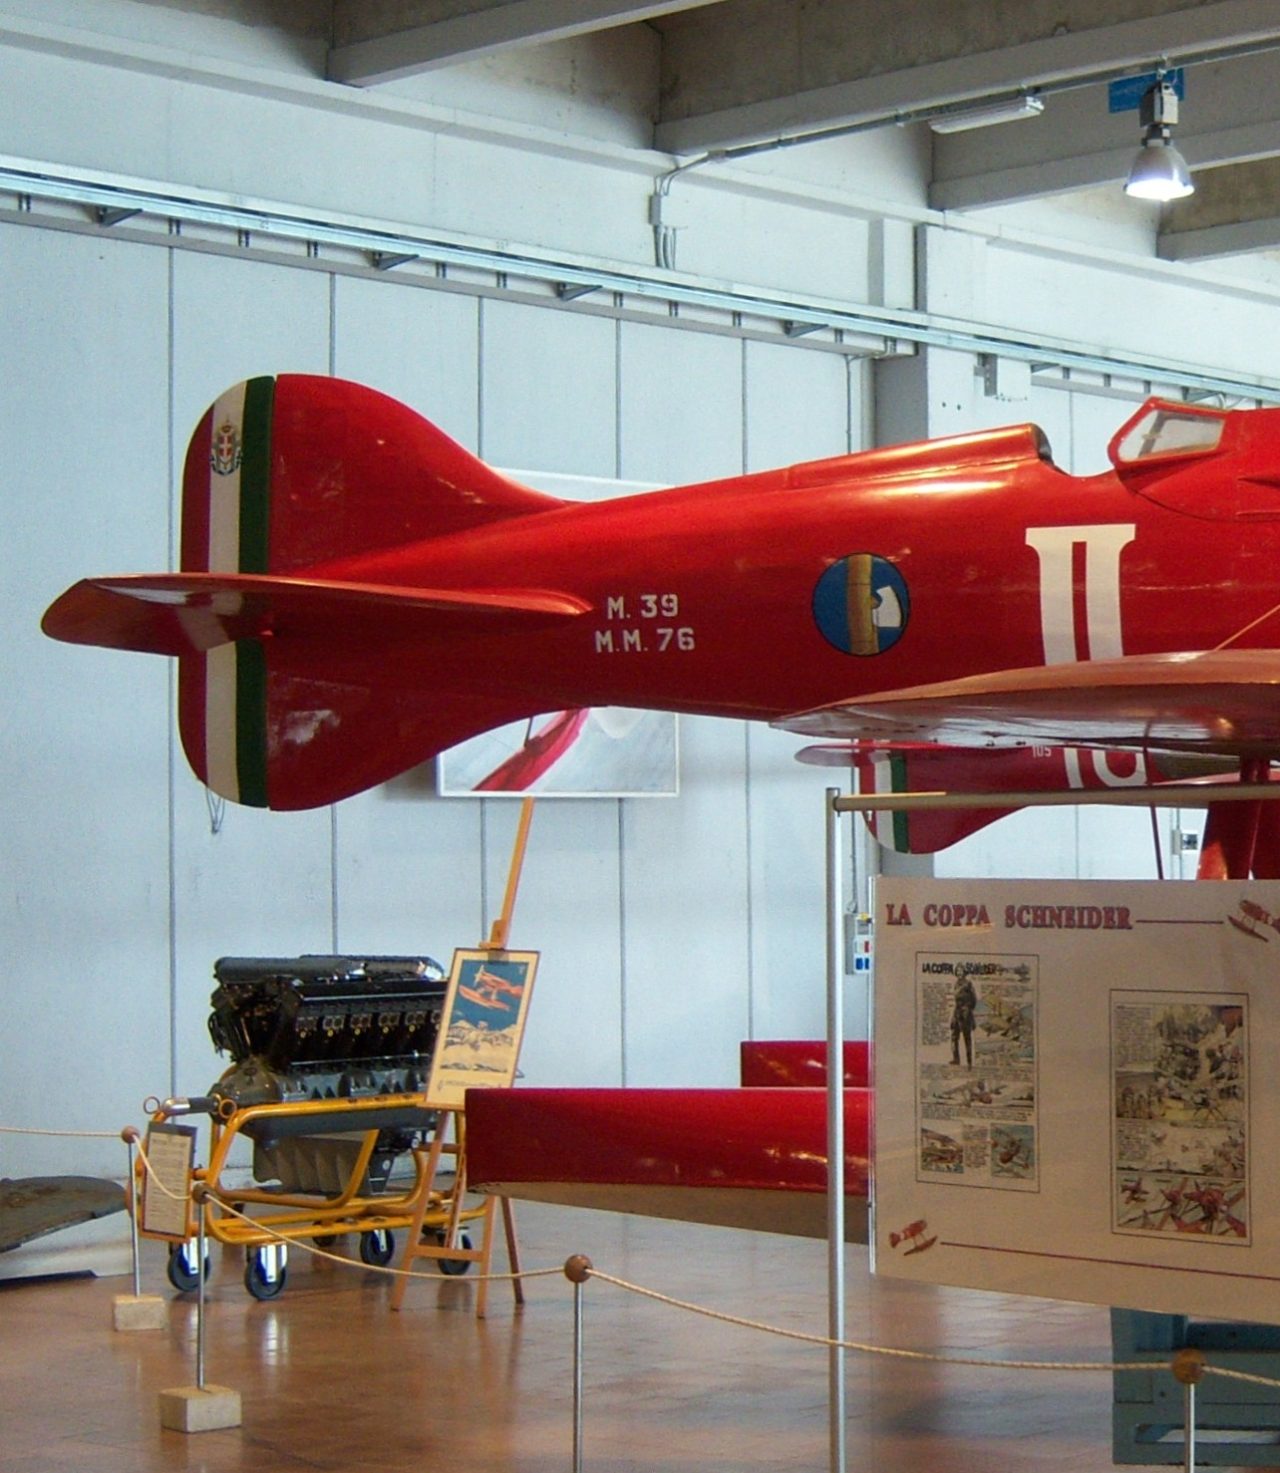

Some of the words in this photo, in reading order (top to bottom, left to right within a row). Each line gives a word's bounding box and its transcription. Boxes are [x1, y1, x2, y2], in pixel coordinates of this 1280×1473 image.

[607, 596, 631, 619] M.
[640, 594, 678, 618] 39
[595, 629, 648, 652] M.M.
[656, 627, 695, 651] 76
[886, 903, 912, 926] LA
[923, 904, 991, 927] COPPA
[1004, 905, 1133, 930] SCHNEIDER
